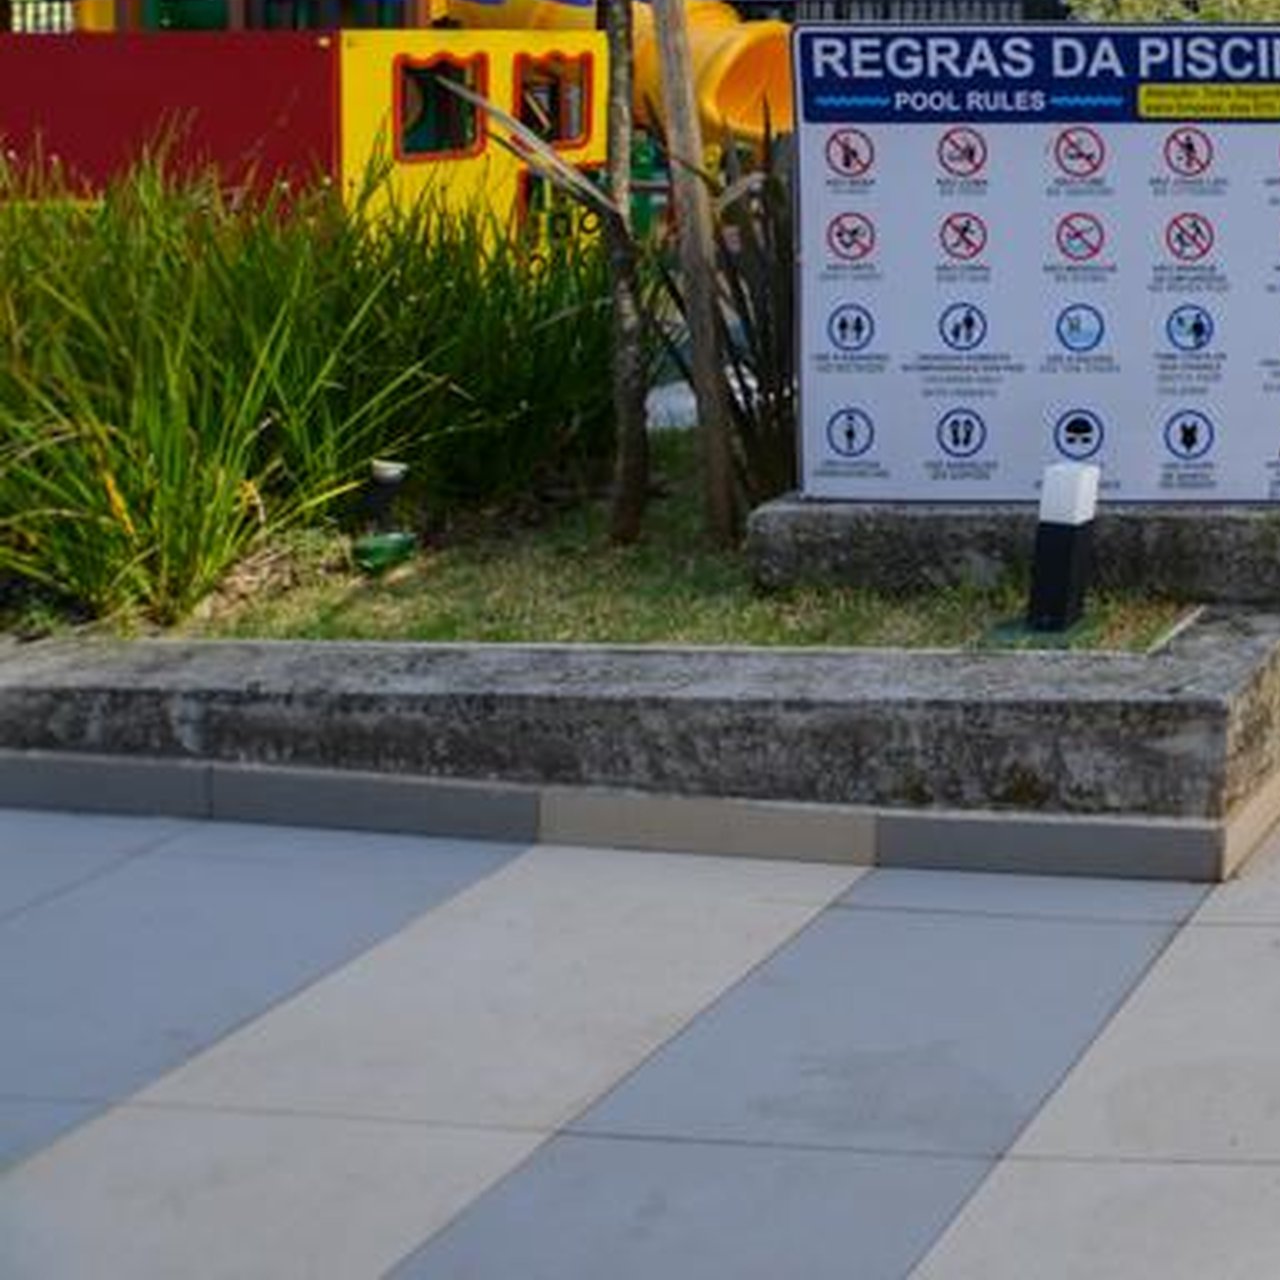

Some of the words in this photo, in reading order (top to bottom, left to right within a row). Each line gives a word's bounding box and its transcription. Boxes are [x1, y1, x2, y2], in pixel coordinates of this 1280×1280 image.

[812, 36, 1035, 79] REGRAS
[1052, 37, 1124, 78] DA
[894, 91, 961, 111] POOL
[966, 91, 1046, 111] RULES
